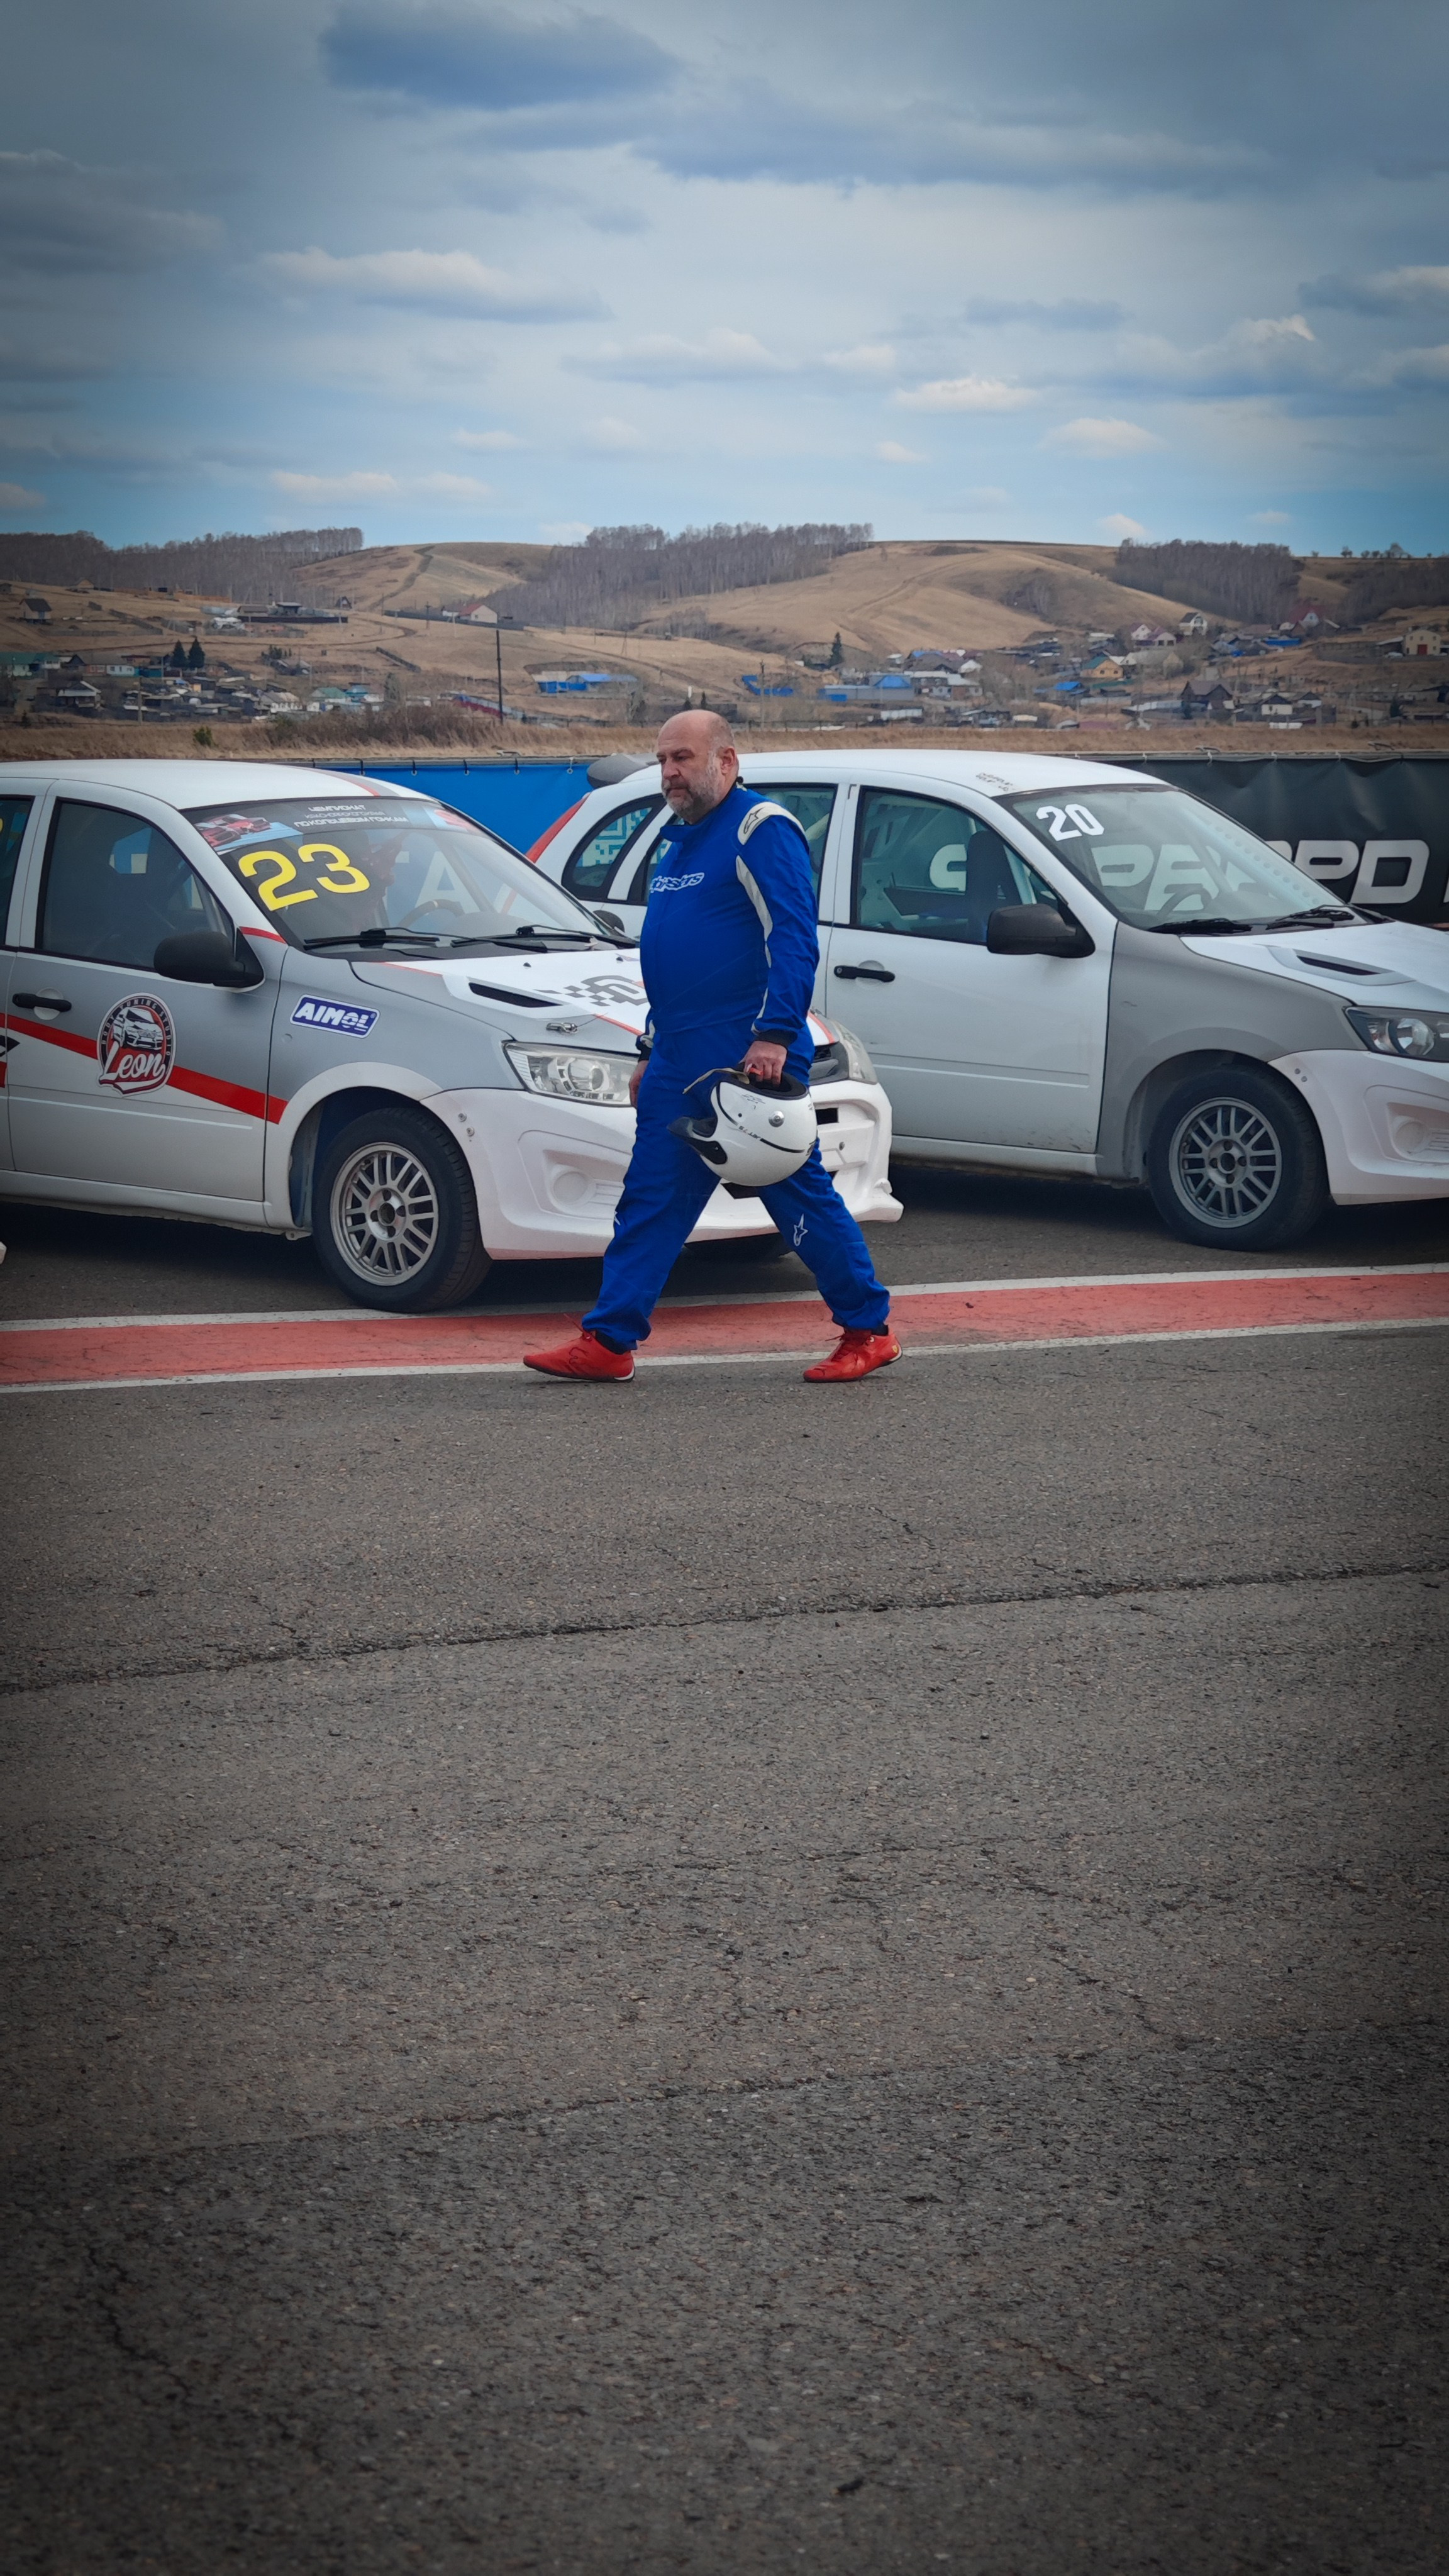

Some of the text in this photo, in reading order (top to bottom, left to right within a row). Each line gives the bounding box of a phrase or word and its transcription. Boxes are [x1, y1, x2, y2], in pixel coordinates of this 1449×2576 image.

[1036, 803, 1105, 841] 20
[238, 843, 370, 911] 23
[119, 999, 157, 1009] TUNING
[159, 1011, 172, 1056] STUDIO
[294, 1002, 369, 1032] AIMOL
[99, 1040, 166, 1081] Leon
